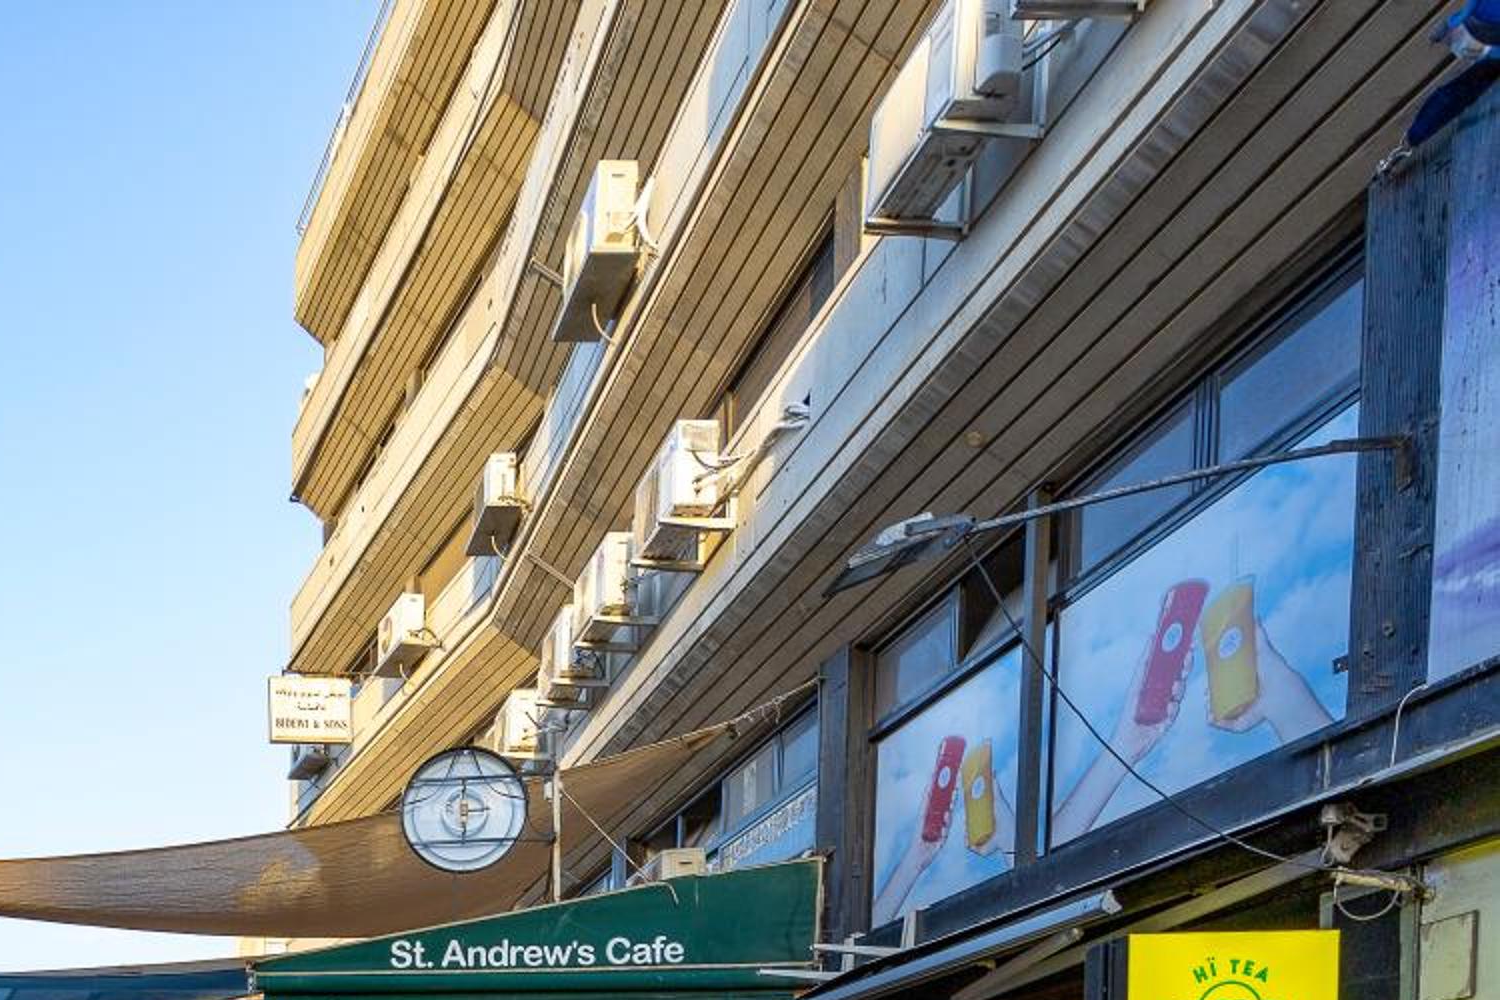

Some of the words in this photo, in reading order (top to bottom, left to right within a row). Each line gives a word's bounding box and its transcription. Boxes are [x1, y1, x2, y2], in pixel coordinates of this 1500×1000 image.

[390, 939, 434, 969] St.
[441, 938, 596, 968] Andrew's
[605, 935, 685, 965] Cafe
[1229, 959, 1269, 983] TEA
